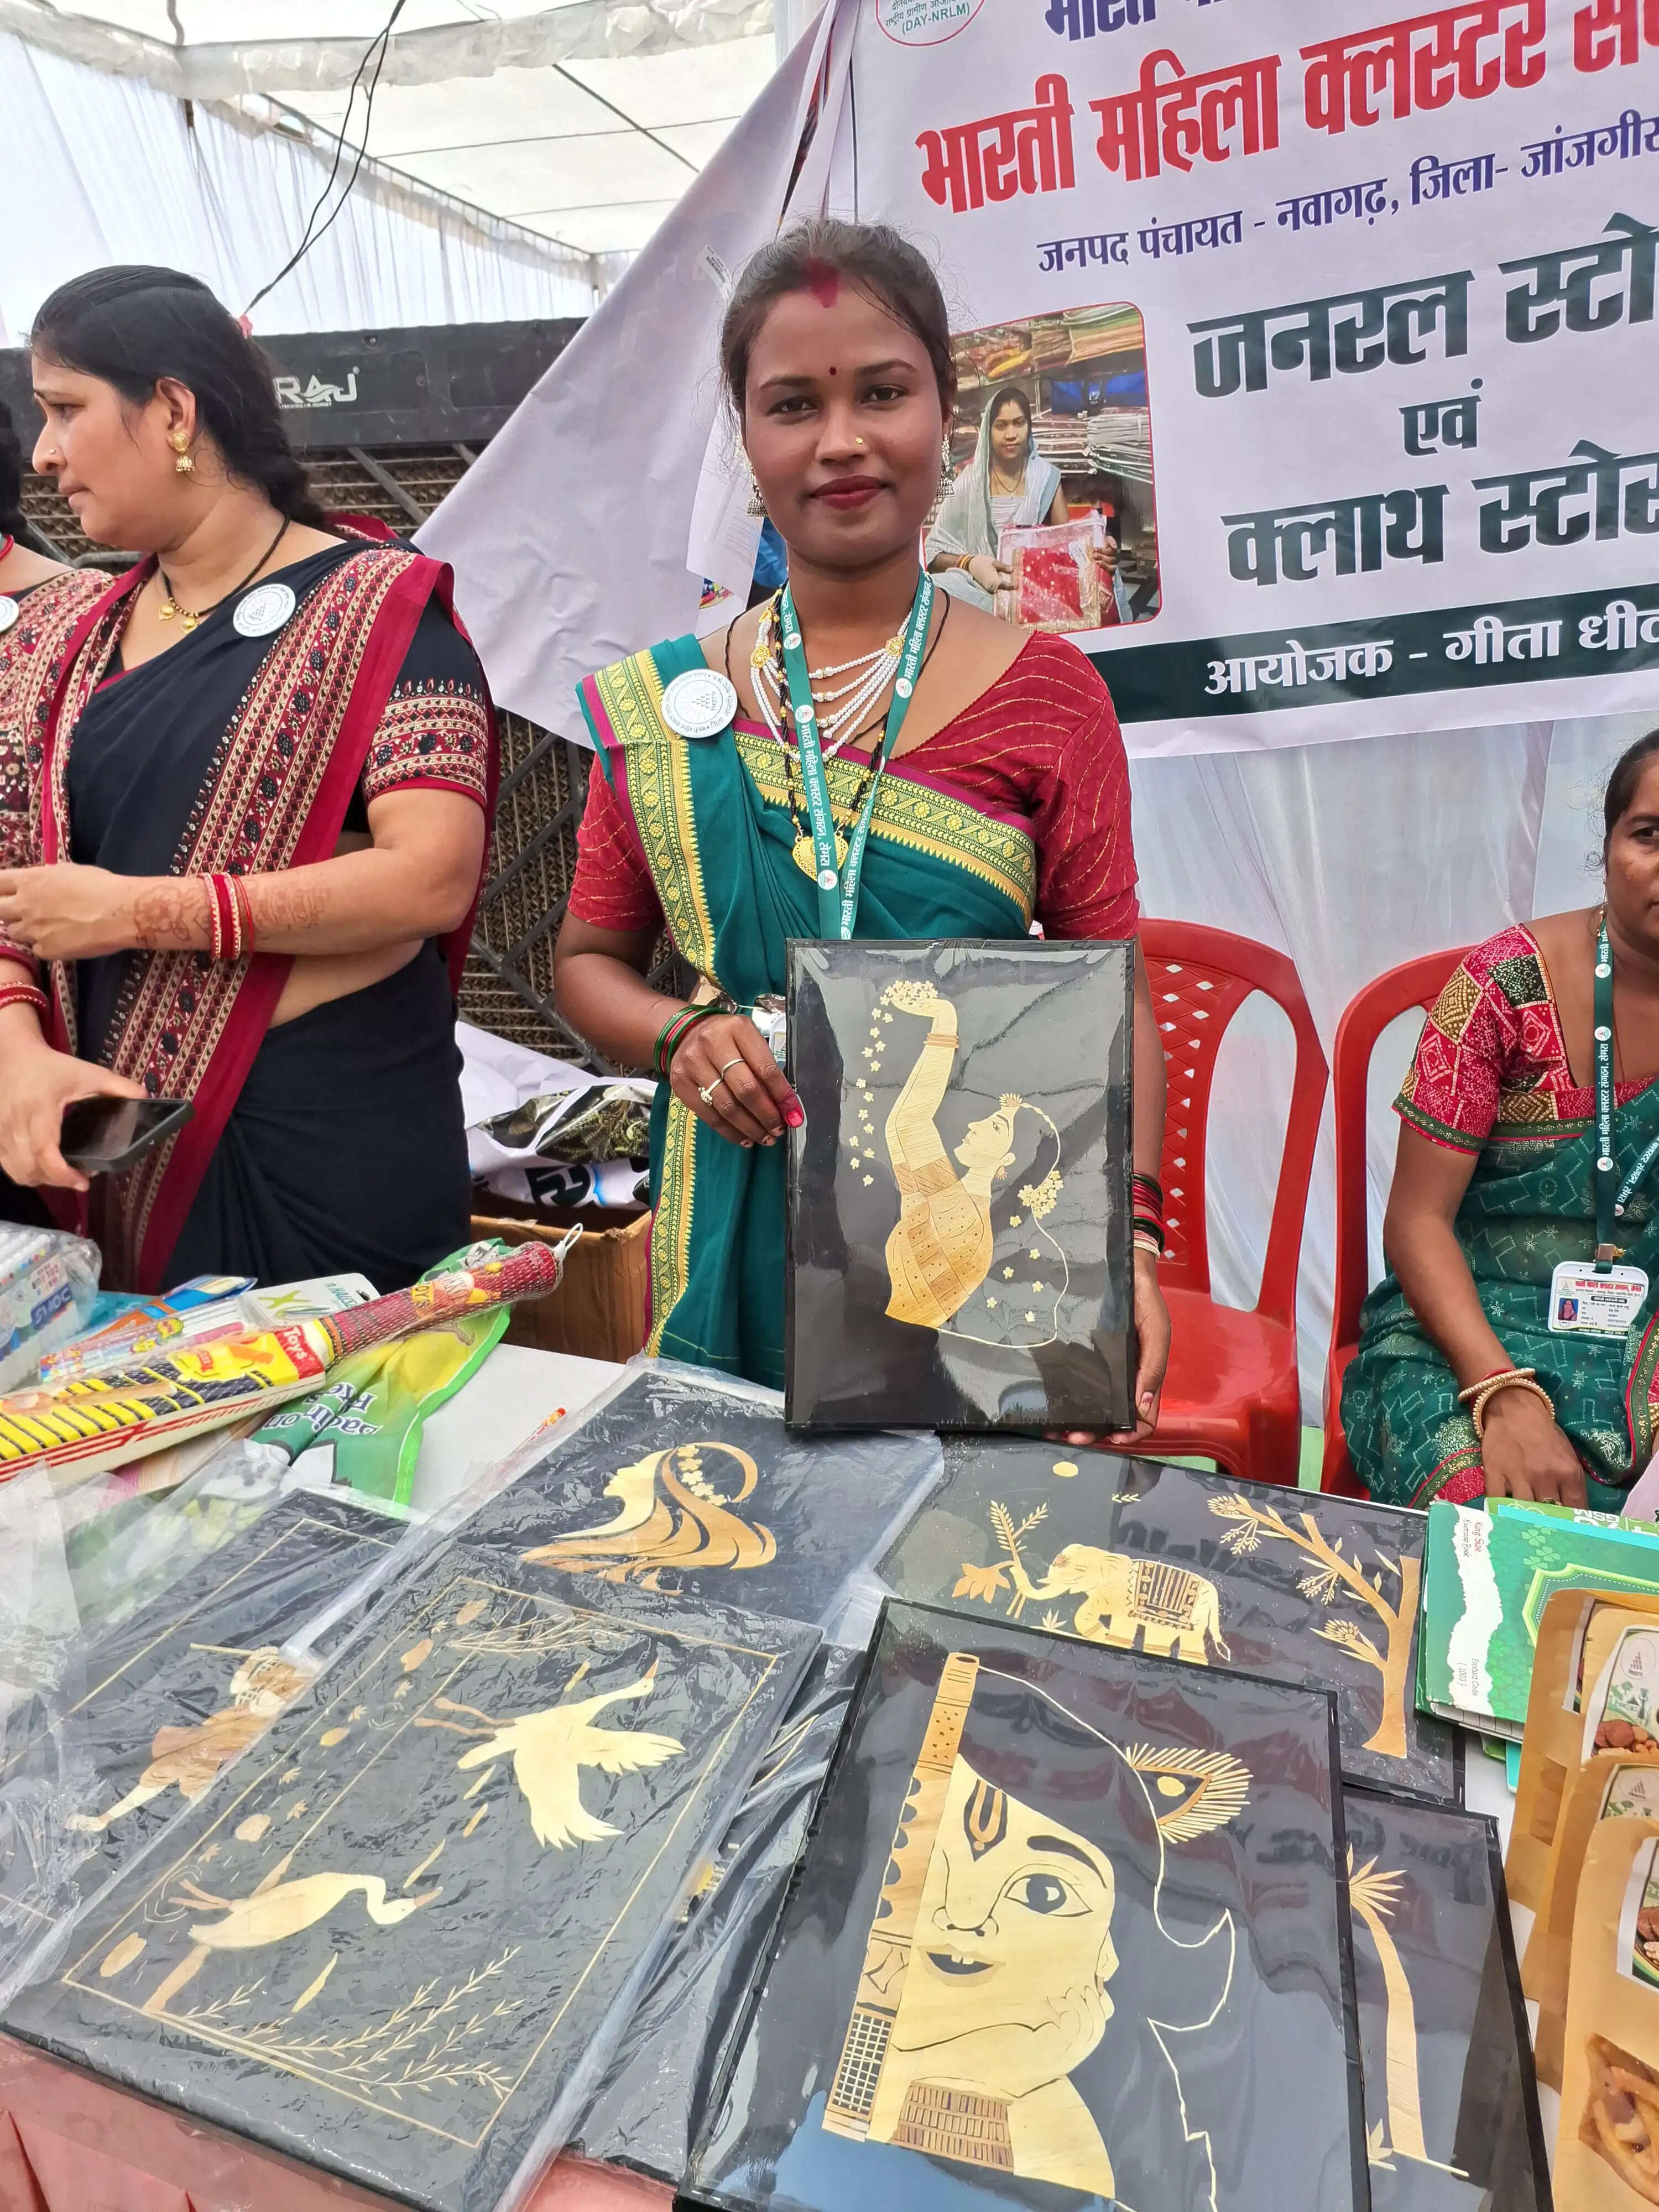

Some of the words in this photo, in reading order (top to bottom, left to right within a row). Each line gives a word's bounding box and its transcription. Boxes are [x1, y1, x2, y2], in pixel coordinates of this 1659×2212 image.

[902, 3, 970, 35] (DAY-NRLM)
[915, 74, 1076, 213] भारती
[1088, 49, 1282, 182] महिला
[1299, 0, 1546, 135] क्लस्टर
[1036, 232, 1129, 272] जनपद
[1138, 211, 1243, 259] पंचायत
[1186, 269, 1475, 398] जनरल
[1498, 212, 1659, 344] स्टो
[1399, 378, 1484, 456] एवं
[1220, 483, 1451, 587] क्लाथ
[1204, 640, 1394, 695] आयोजक
[1443, 616, 1562, 665] गीता
[801, 723, 816, 749] भारती
[804, 750, 818, 775] महिला
[283, 1327, 307, 1360] Toys
[1573, 1508, 1620, 1523] GSM
